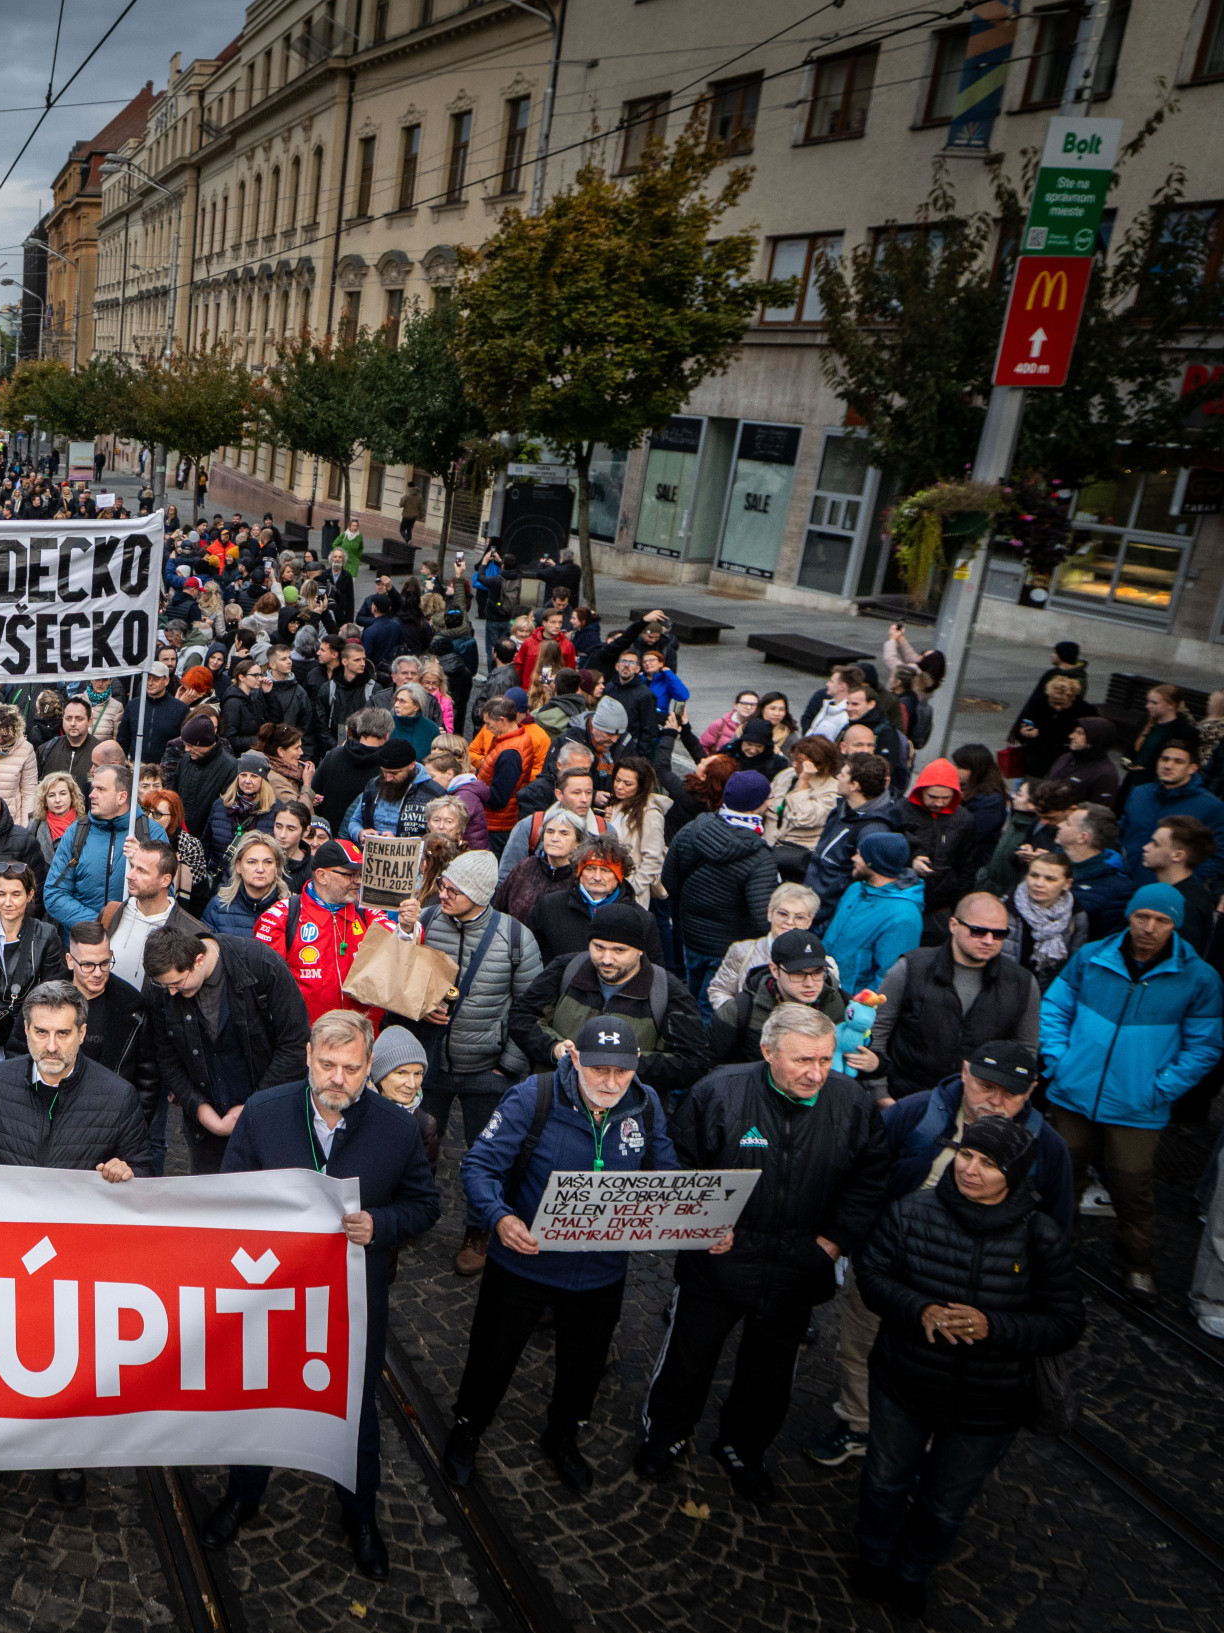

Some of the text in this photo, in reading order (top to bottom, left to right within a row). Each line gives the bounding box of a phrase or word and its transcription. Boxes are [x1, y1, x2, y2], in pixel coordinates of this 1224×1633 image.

[1062, 132, 1103, 160] Bolt
[1013, 362, 1051, 374] 400 m
[656, 483, 678, 503] SALE
[744, 492, 772, 514] SALE
[367, 841, 418, 858] GENERÁLNY
[365, 854, 415, 879] ŠTRAJK
[364, 874, 413, 891] 17.11.2025
[302, 922, 317, 942] hp
[300, 968, 322, 979] IBM
[739, 1136, 769, 1146] adidas
[557, 1173, 722, 1189] VAŠA KONSOLIDÁCIA
[554, 1187, 590, 1202] NÁS
[543, 1201, 710, 1217] UŽ LEN VEĽKÝ BIČ,
[551, 1215, 600, 1229] MALÝ
[629, 1229, 653, 1241] NA
